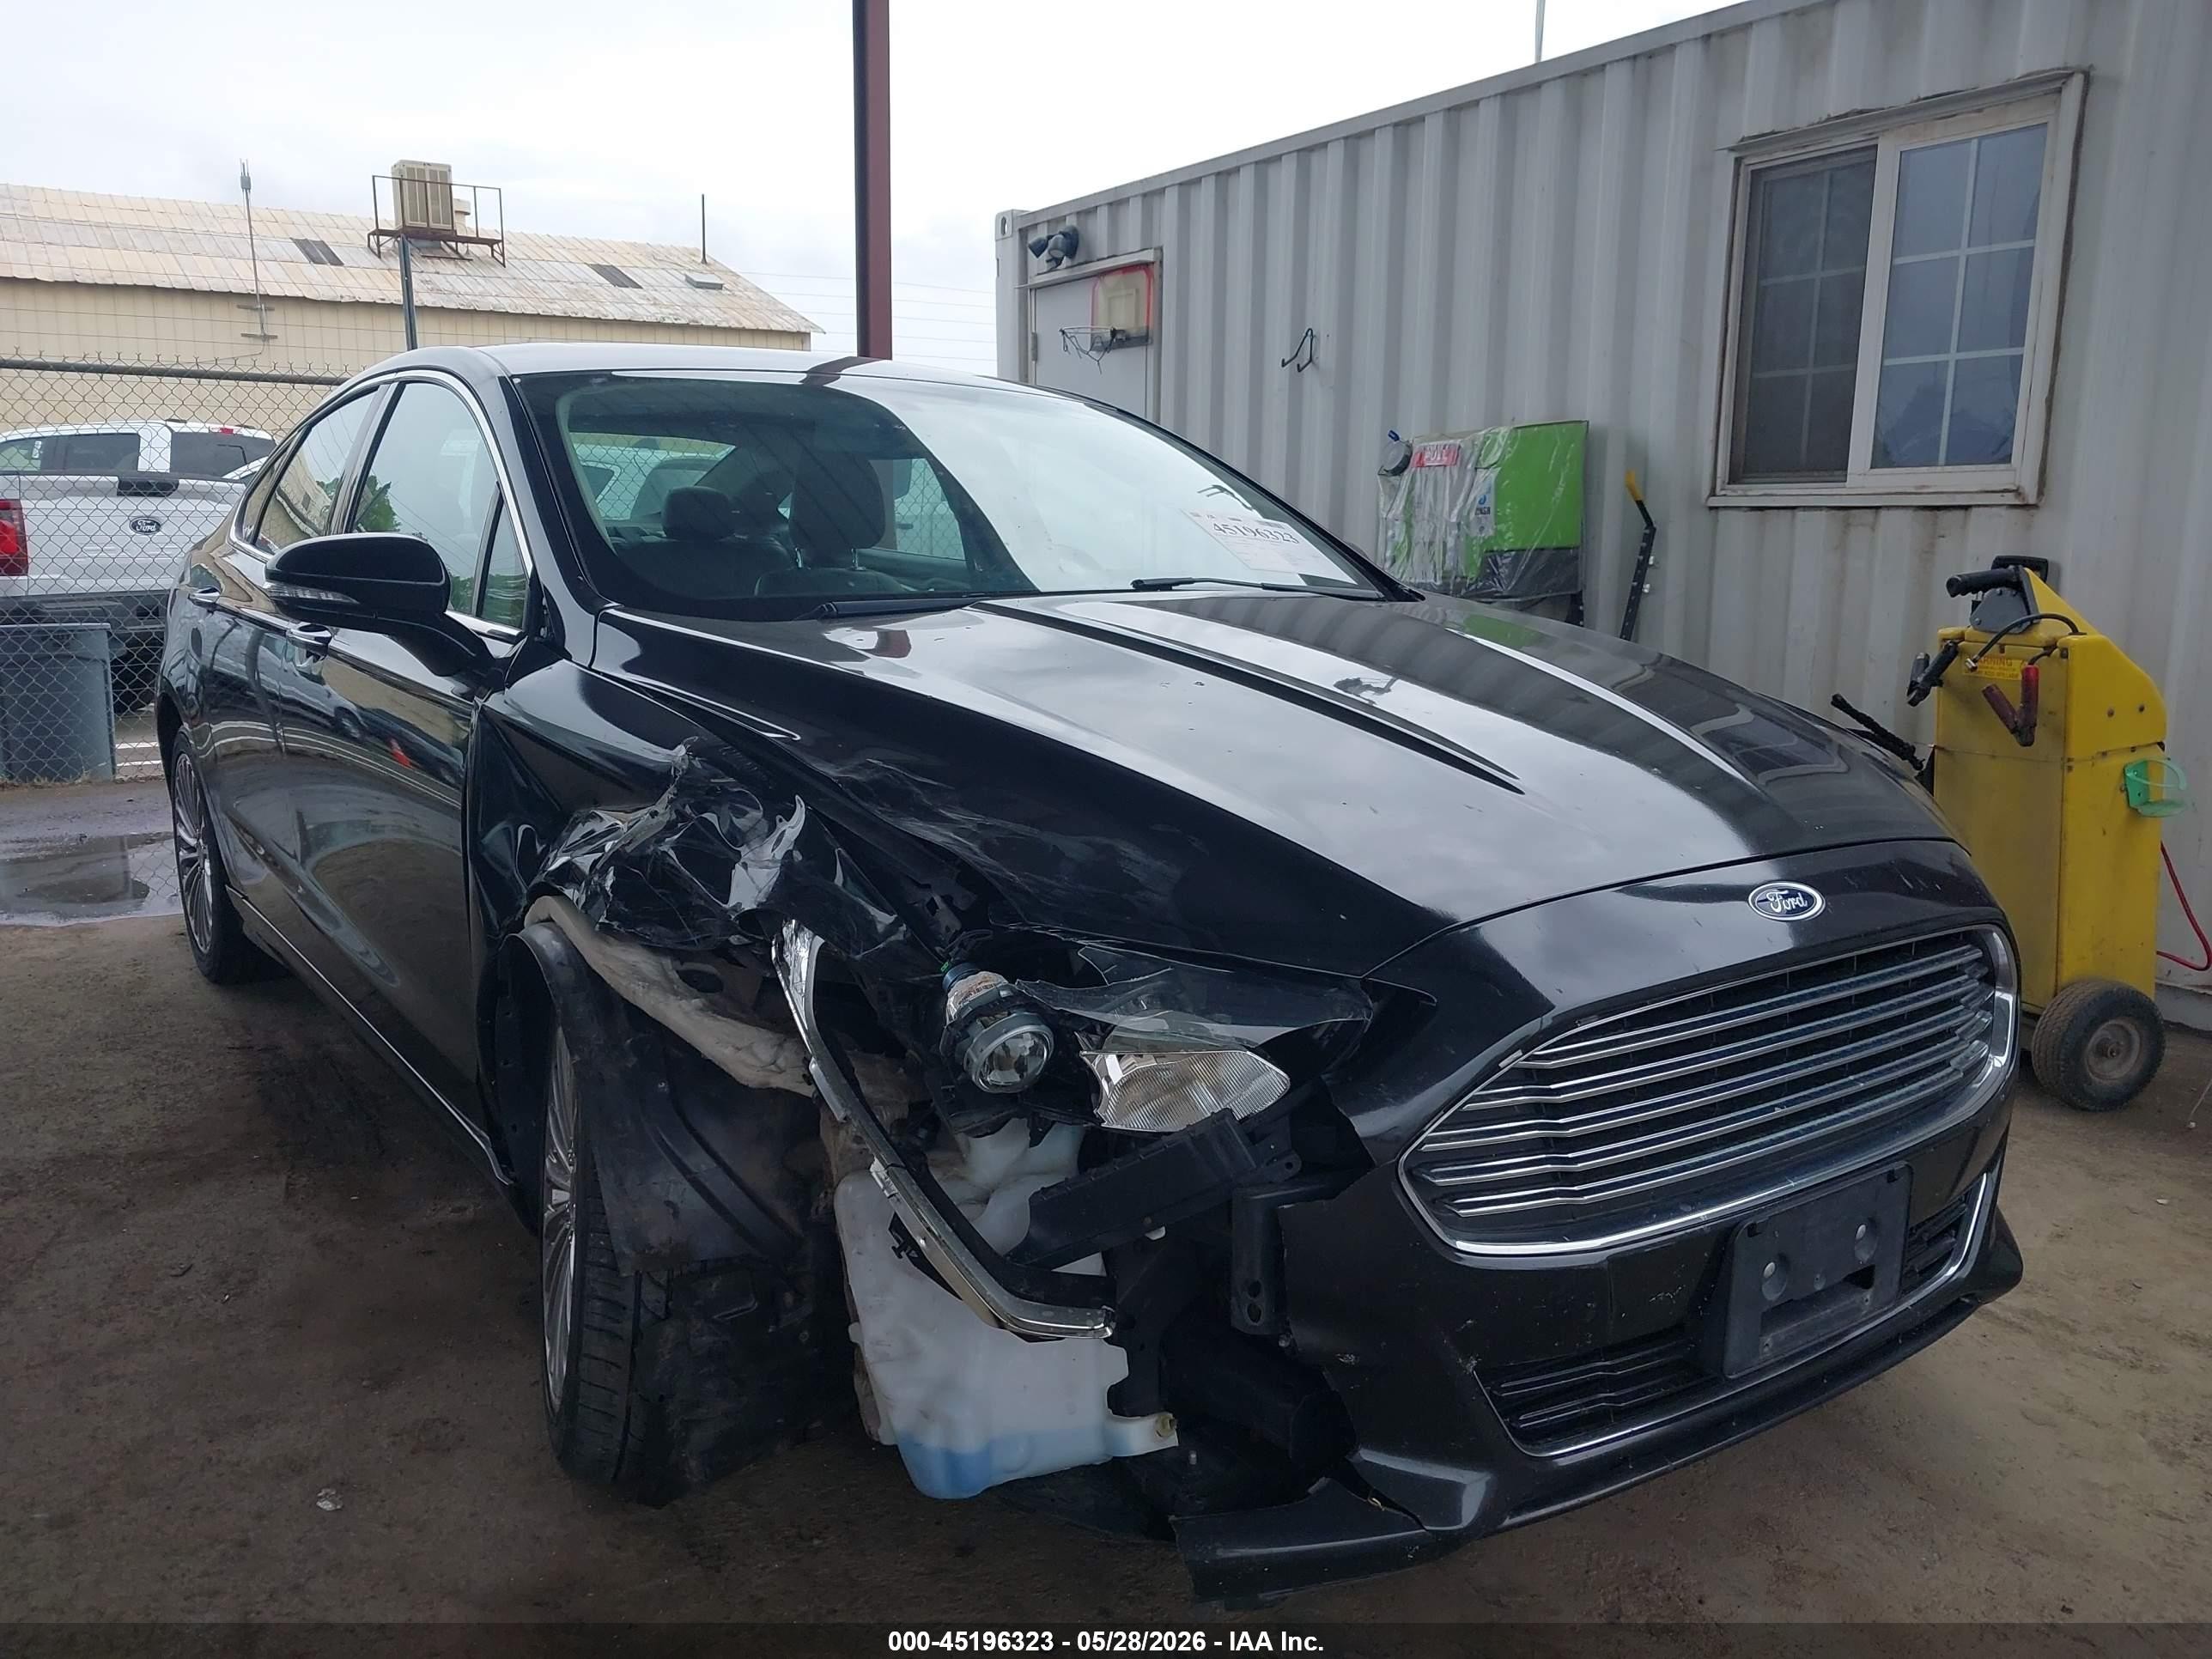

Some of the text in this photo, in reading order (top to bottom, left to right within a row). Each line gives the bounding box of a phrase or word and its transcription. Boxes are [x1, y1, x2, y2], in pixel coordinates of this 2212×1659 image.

[136, 520, 157, 532] Ford
[1212, 522, 1300, 545] 45196323
[1765, 889, 1808, 913] Ford
